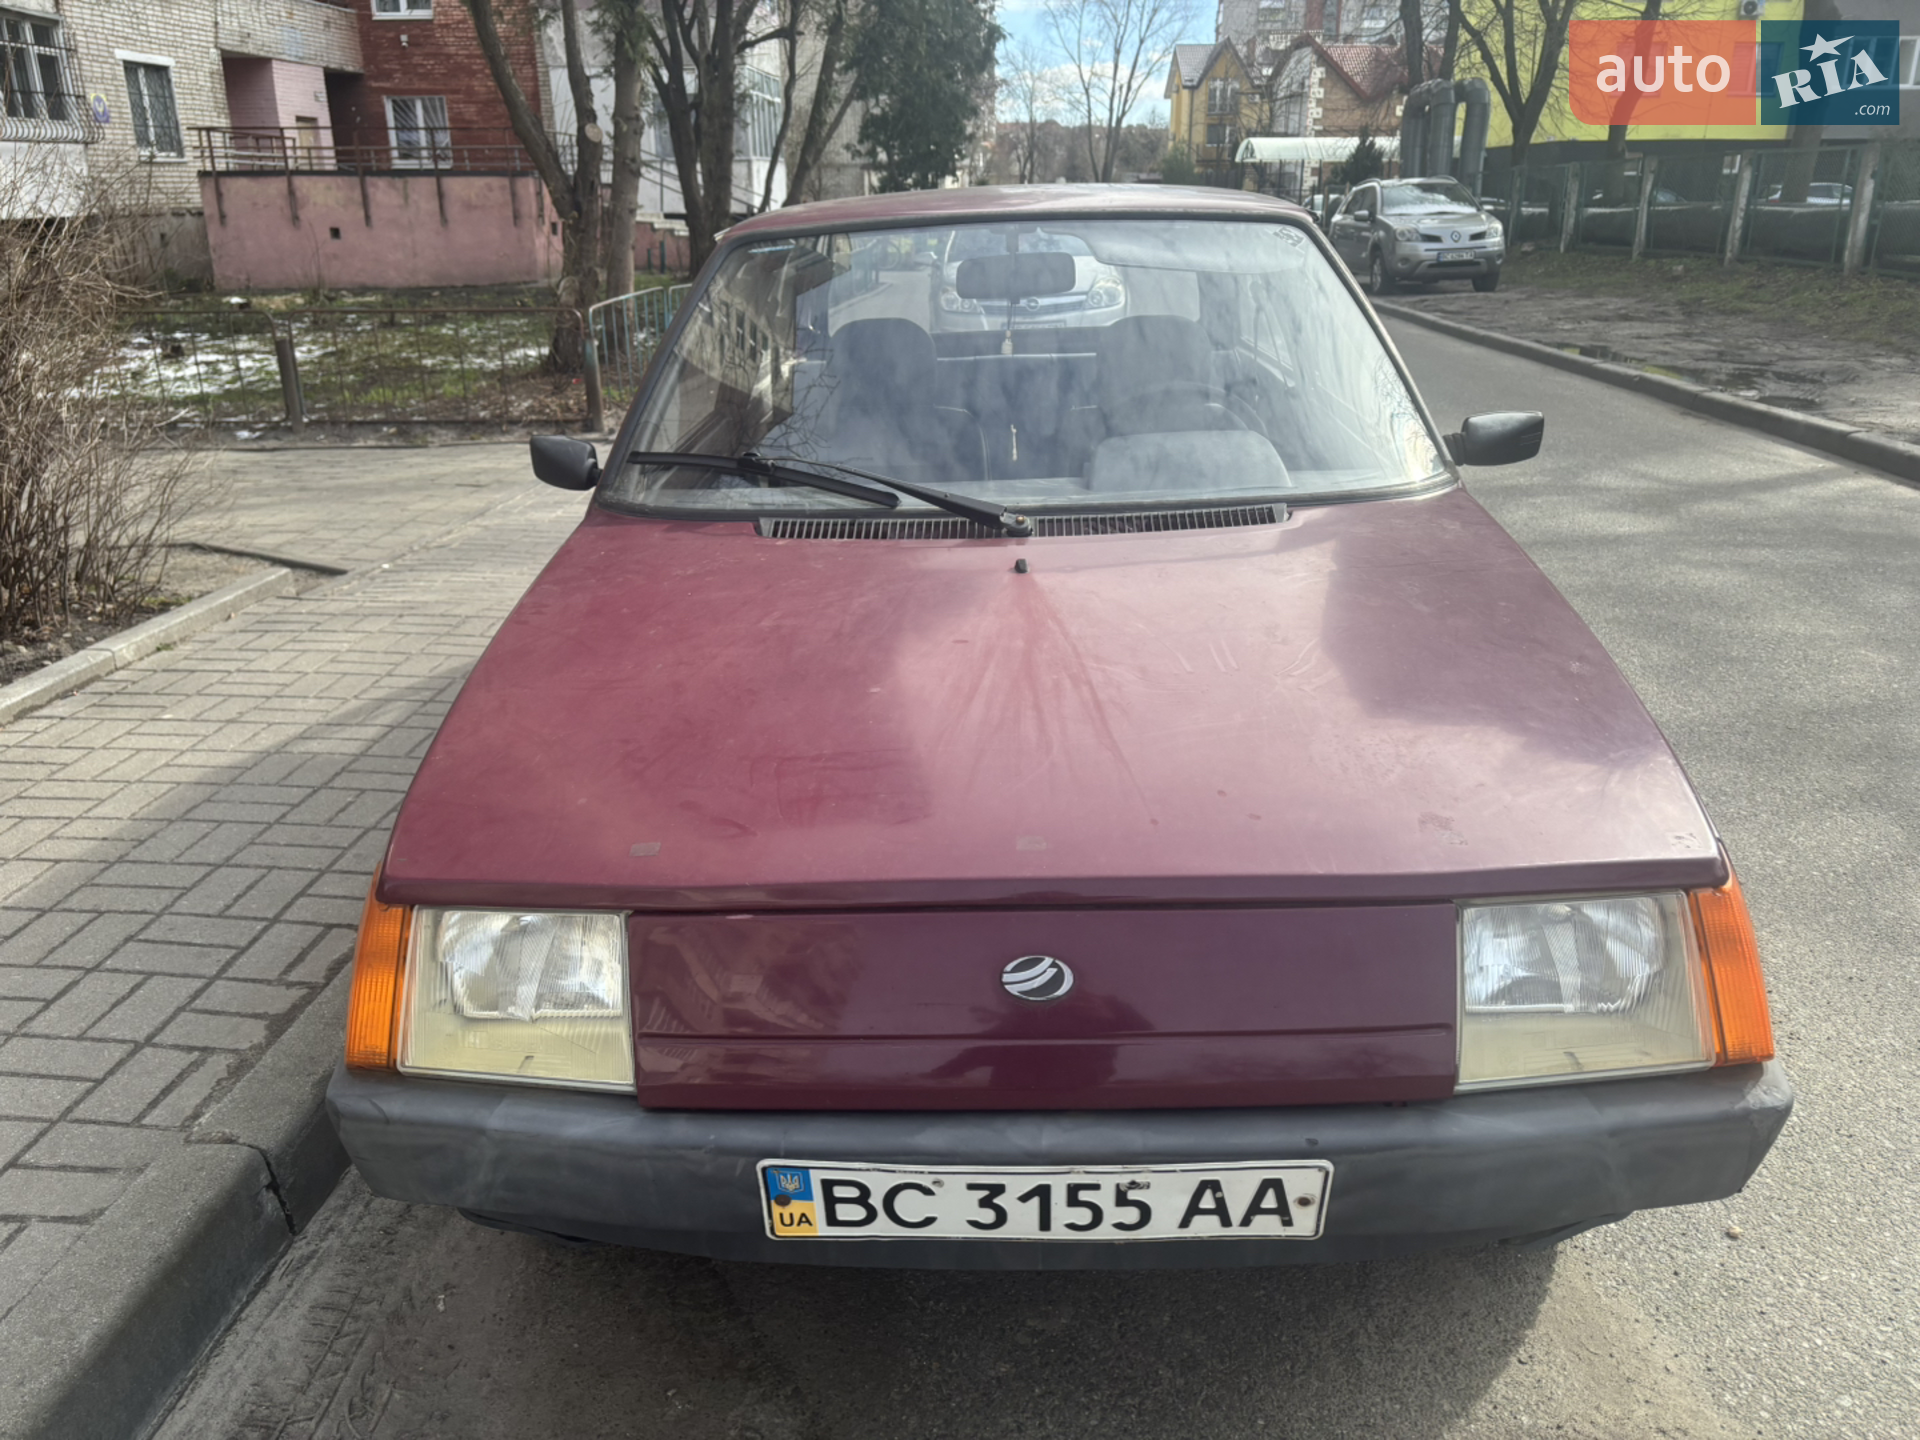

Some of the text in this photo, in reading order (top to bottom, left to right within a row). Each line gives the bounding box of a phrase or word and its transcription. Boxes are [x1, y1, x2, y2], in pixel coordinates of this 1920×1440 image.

[779, 1212, 813, 1228] UA
[820, 1178, 1294, 1233] BC 3155 AA
